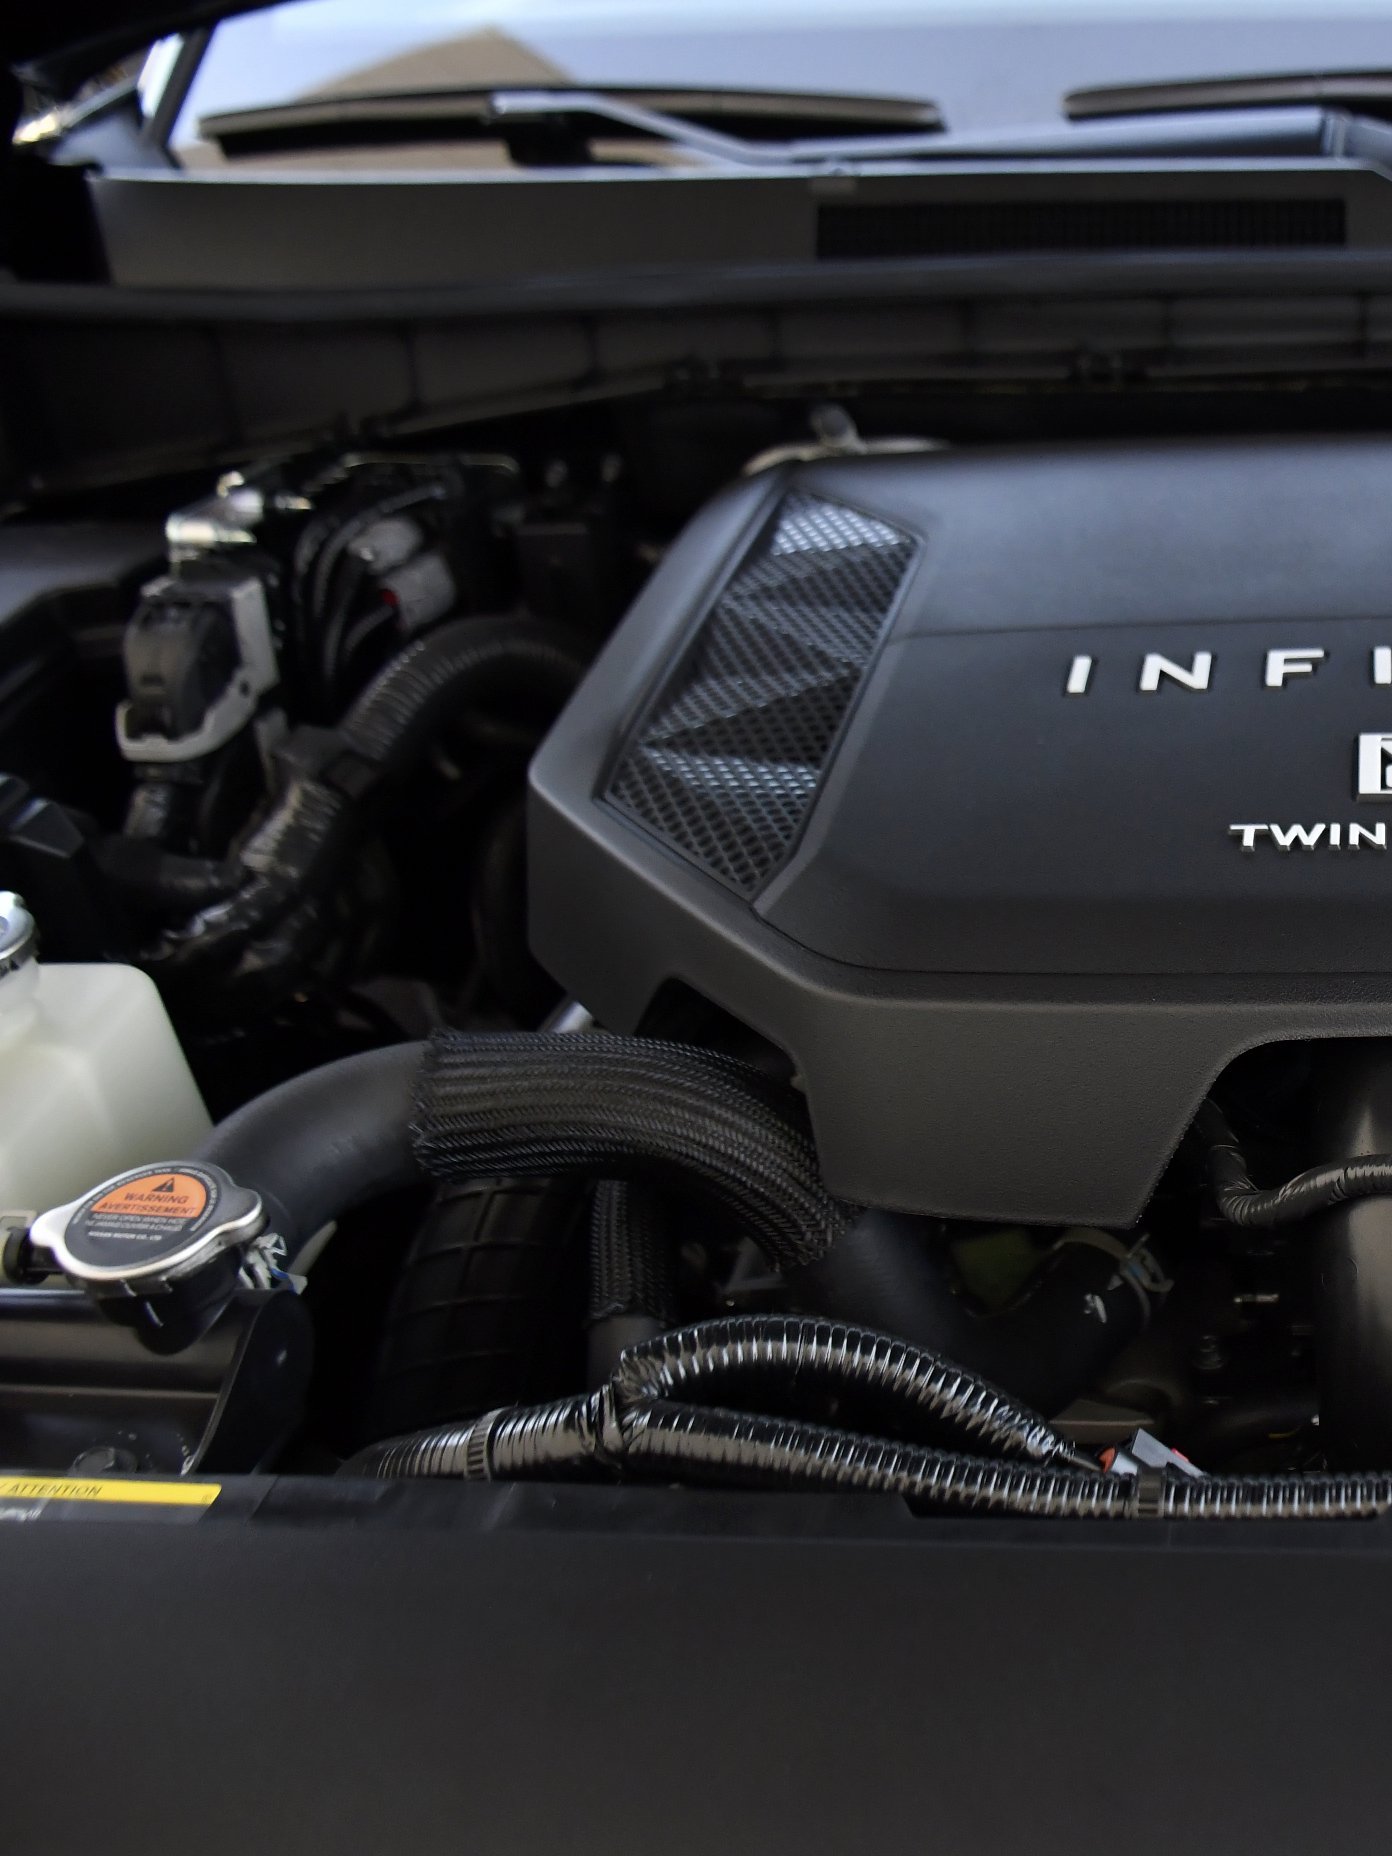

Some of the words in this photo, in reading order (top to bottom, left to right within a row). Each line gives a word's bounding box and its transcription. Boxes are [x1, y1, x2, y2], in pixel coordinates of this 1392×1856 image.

[1228, 822, 1387, 852] TWIN
[124, 1192, 190, 1204] WARNING
[100, 1202, 197, 1214] AVERTISSEMENT
[7, 1483, 104, 1496] ATTENTION
